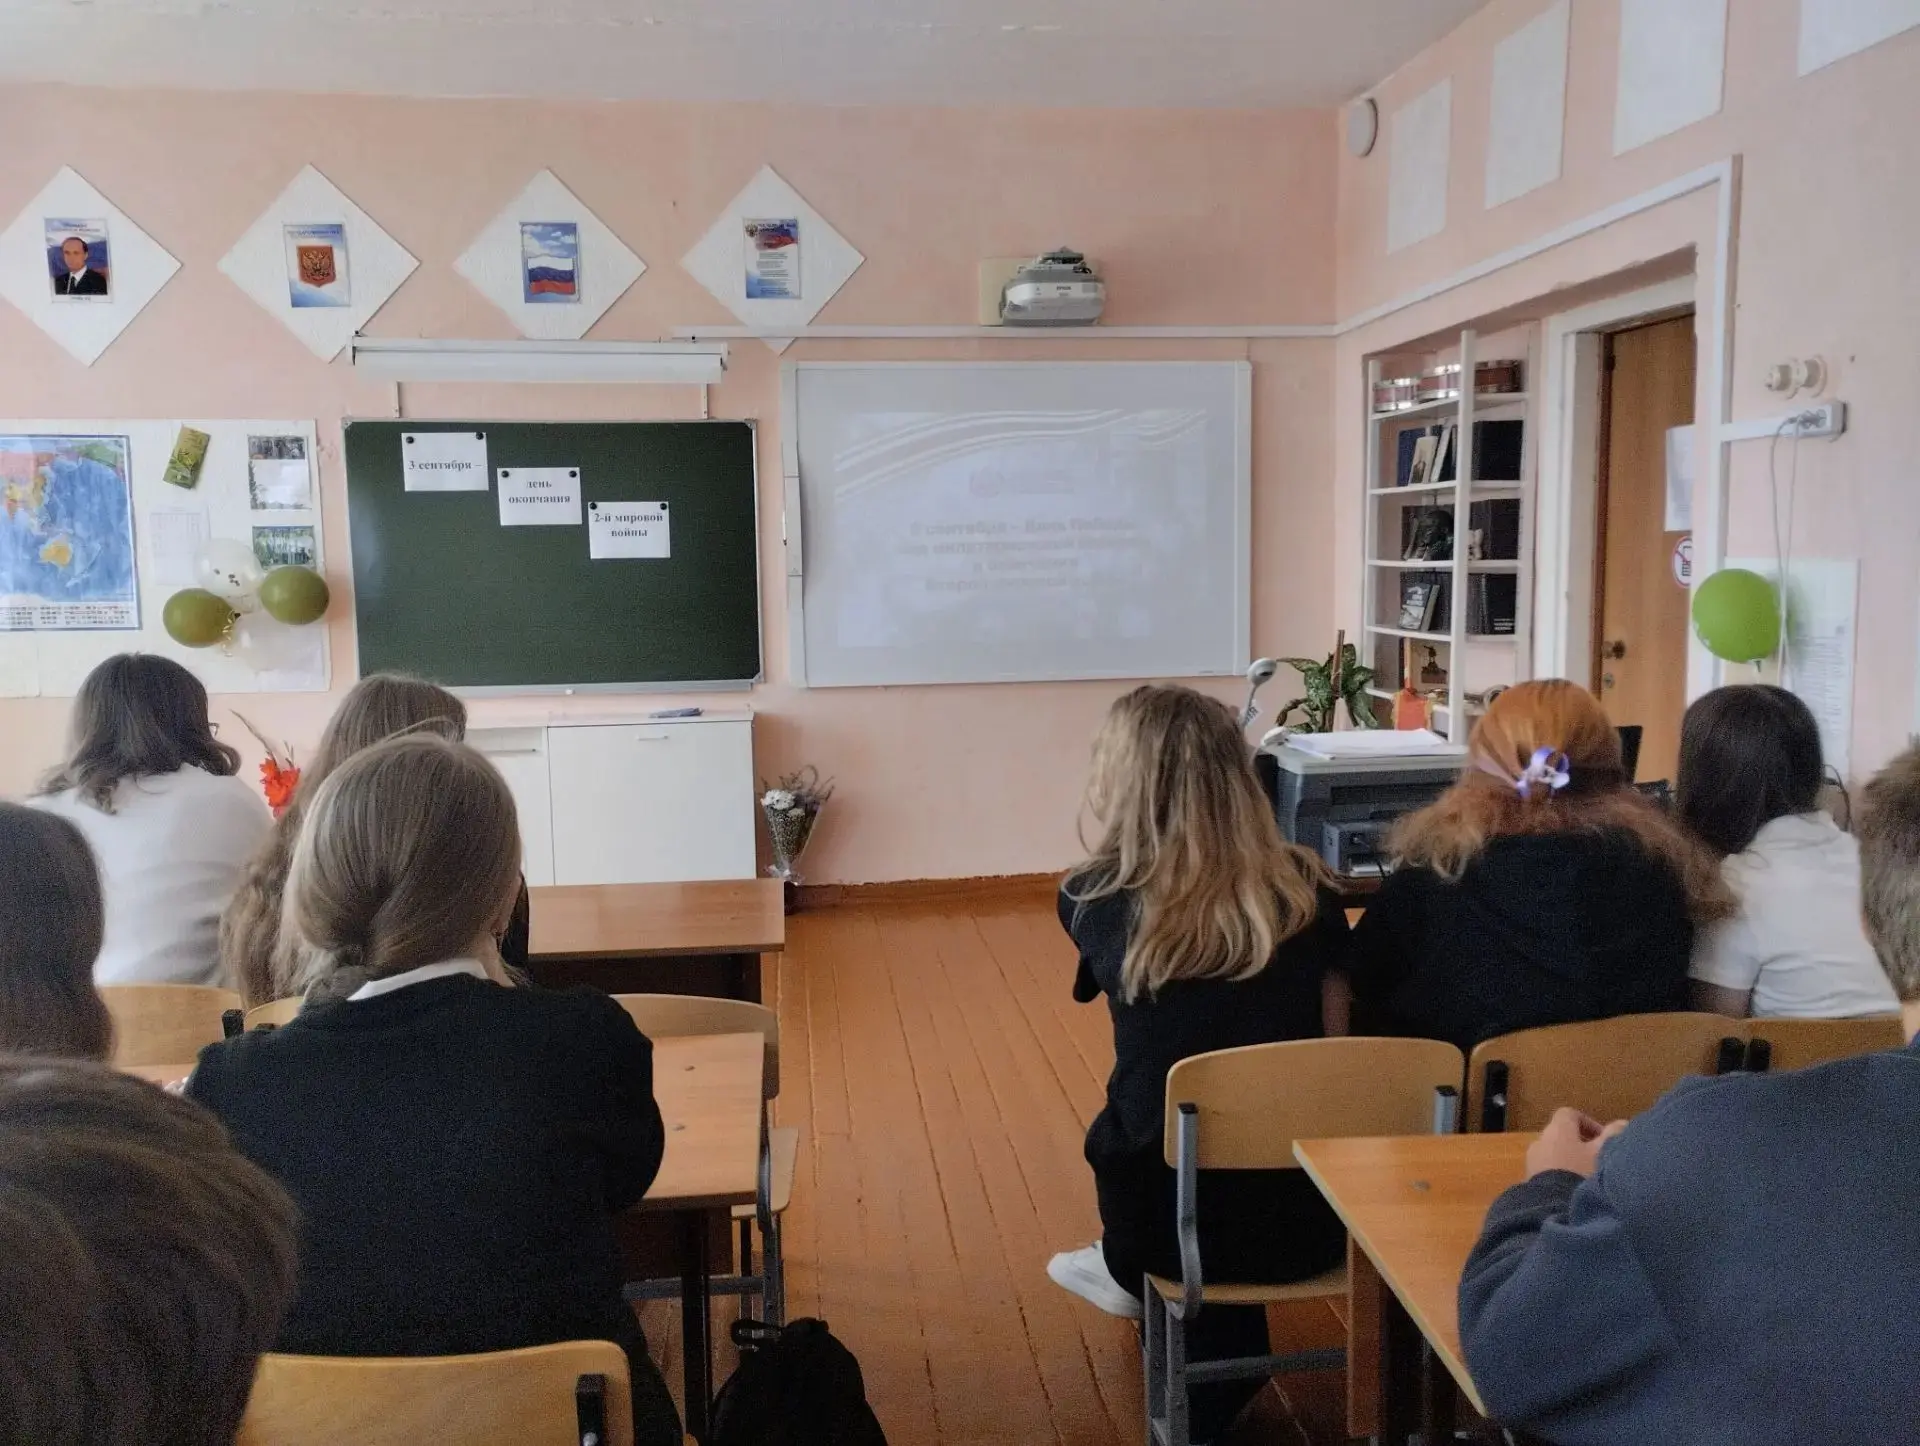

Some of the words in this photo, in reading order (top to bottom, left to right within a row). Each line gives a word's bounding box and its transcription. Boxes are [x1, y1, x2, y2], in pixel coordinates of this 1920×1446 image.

[408, 460, 415, 471] 3
[418, 459, 472, 472] сентября
[526, 480, 552, 489] день
[508, 495, 571, 505] окончания
[594, 511, 611, 523] 2-й
[615, 511, 663, 525] мировой
[610, 527, 648, 537] войны
